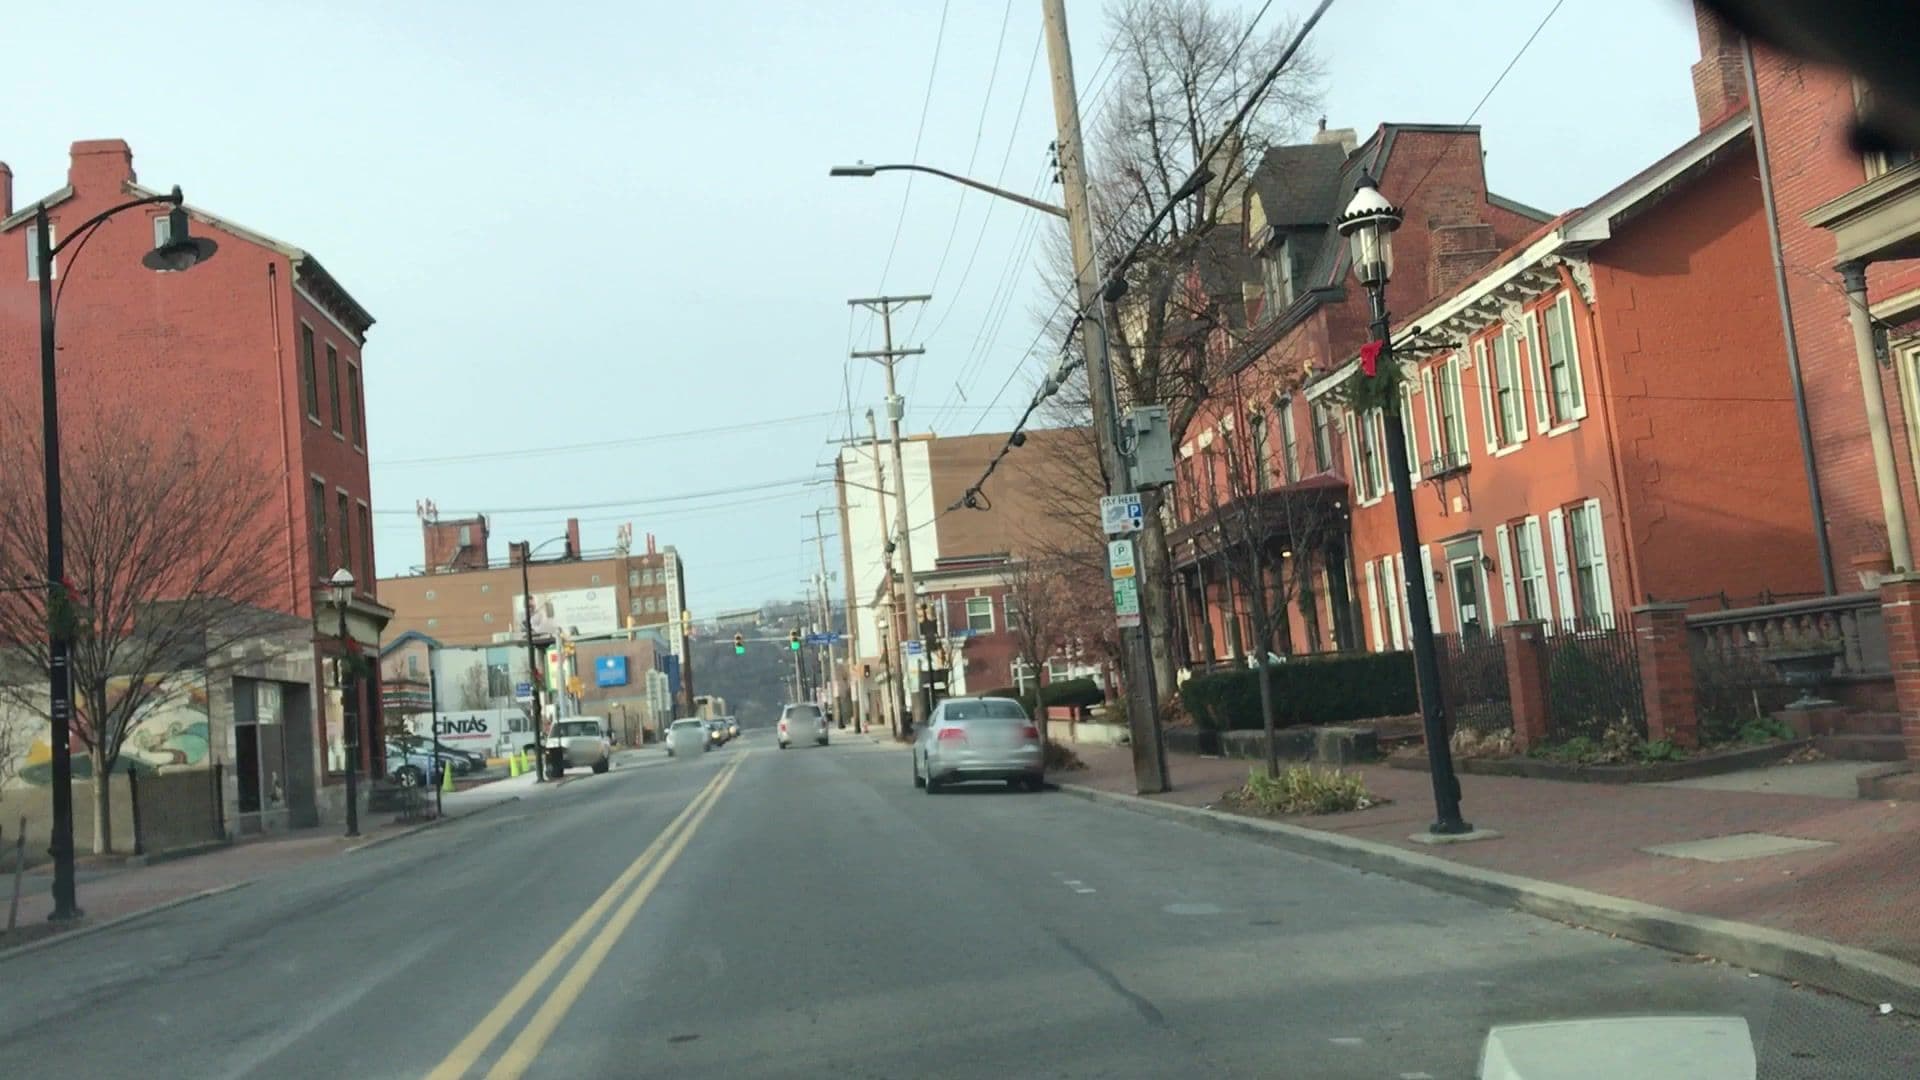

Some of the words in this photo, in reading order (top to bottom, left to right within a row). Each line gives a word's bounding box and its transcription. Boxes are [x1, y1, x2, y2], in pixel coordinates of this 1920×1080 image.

[1102, 497, 1116, 507] PAY
[1118, 495, 1137, 505] HERE
[1130, 504, 1139, 517] P
